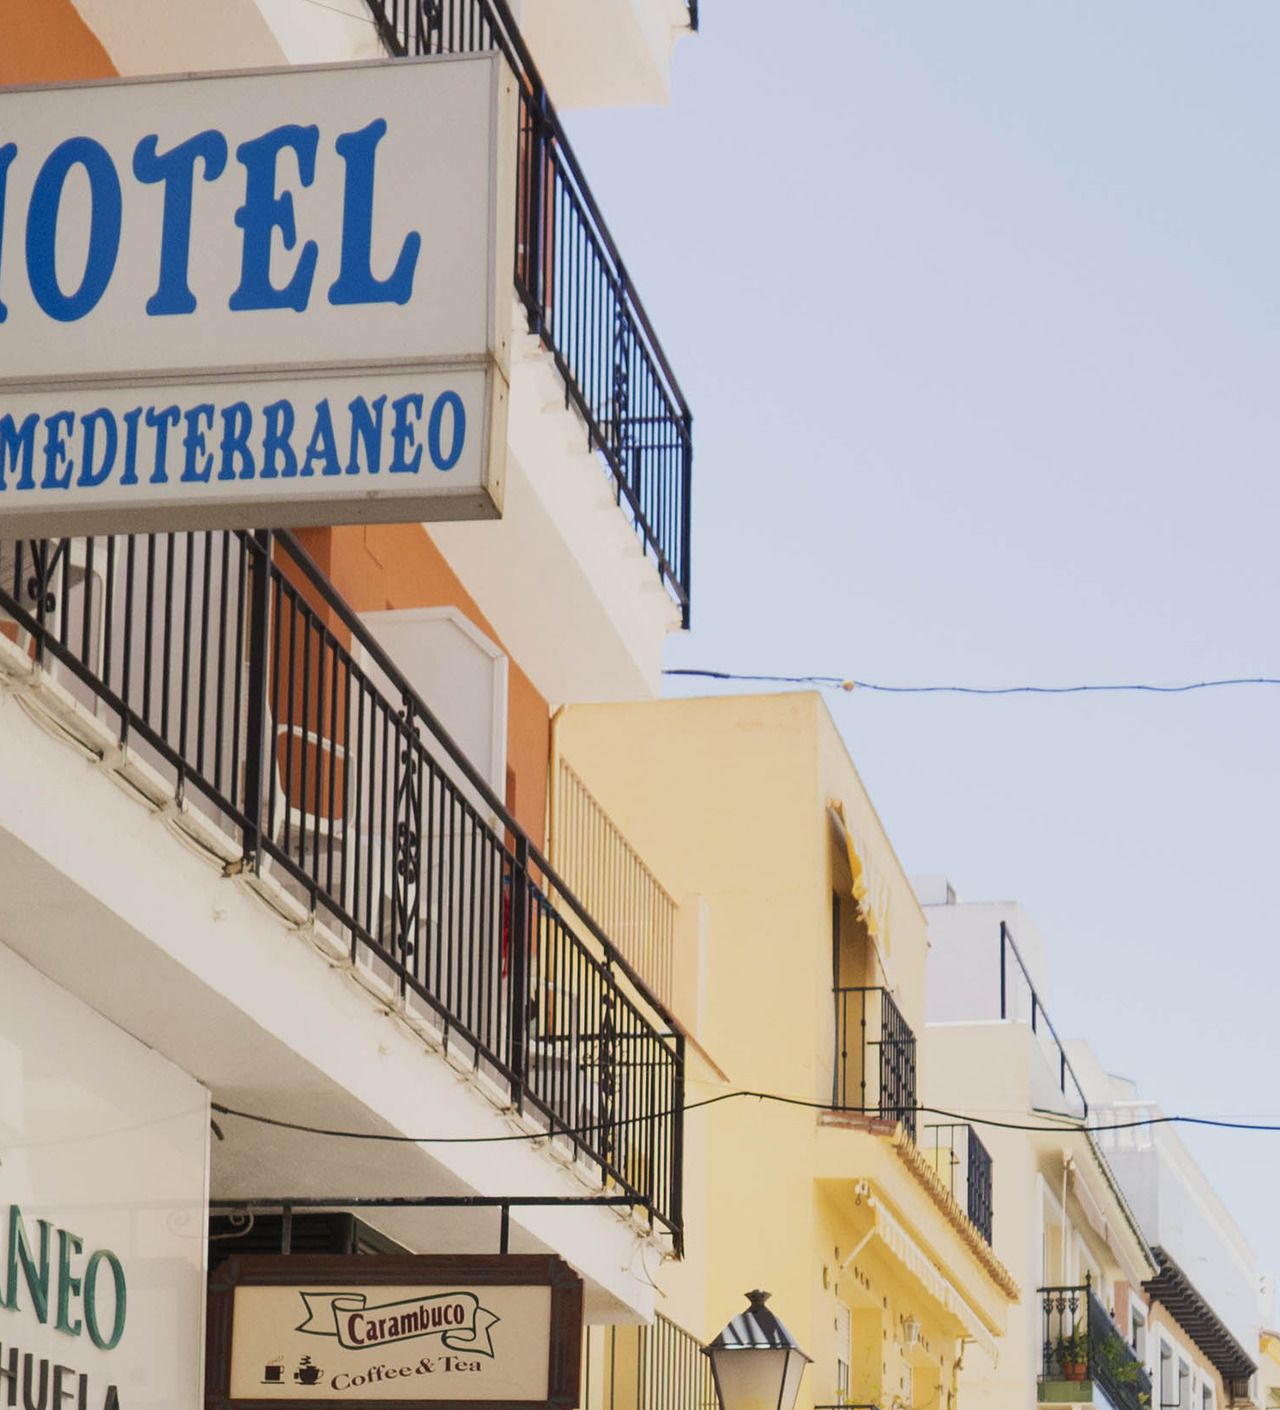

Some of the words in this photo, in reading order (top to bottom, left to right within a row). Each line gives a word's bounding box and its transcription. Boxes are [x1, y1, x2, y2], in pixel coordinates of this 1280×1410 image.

[347, 1303, 465, 1345] Carambuco
[331, 1364, 413, 1391] Coffee
[438, 1355, 482, 1373] Tea
